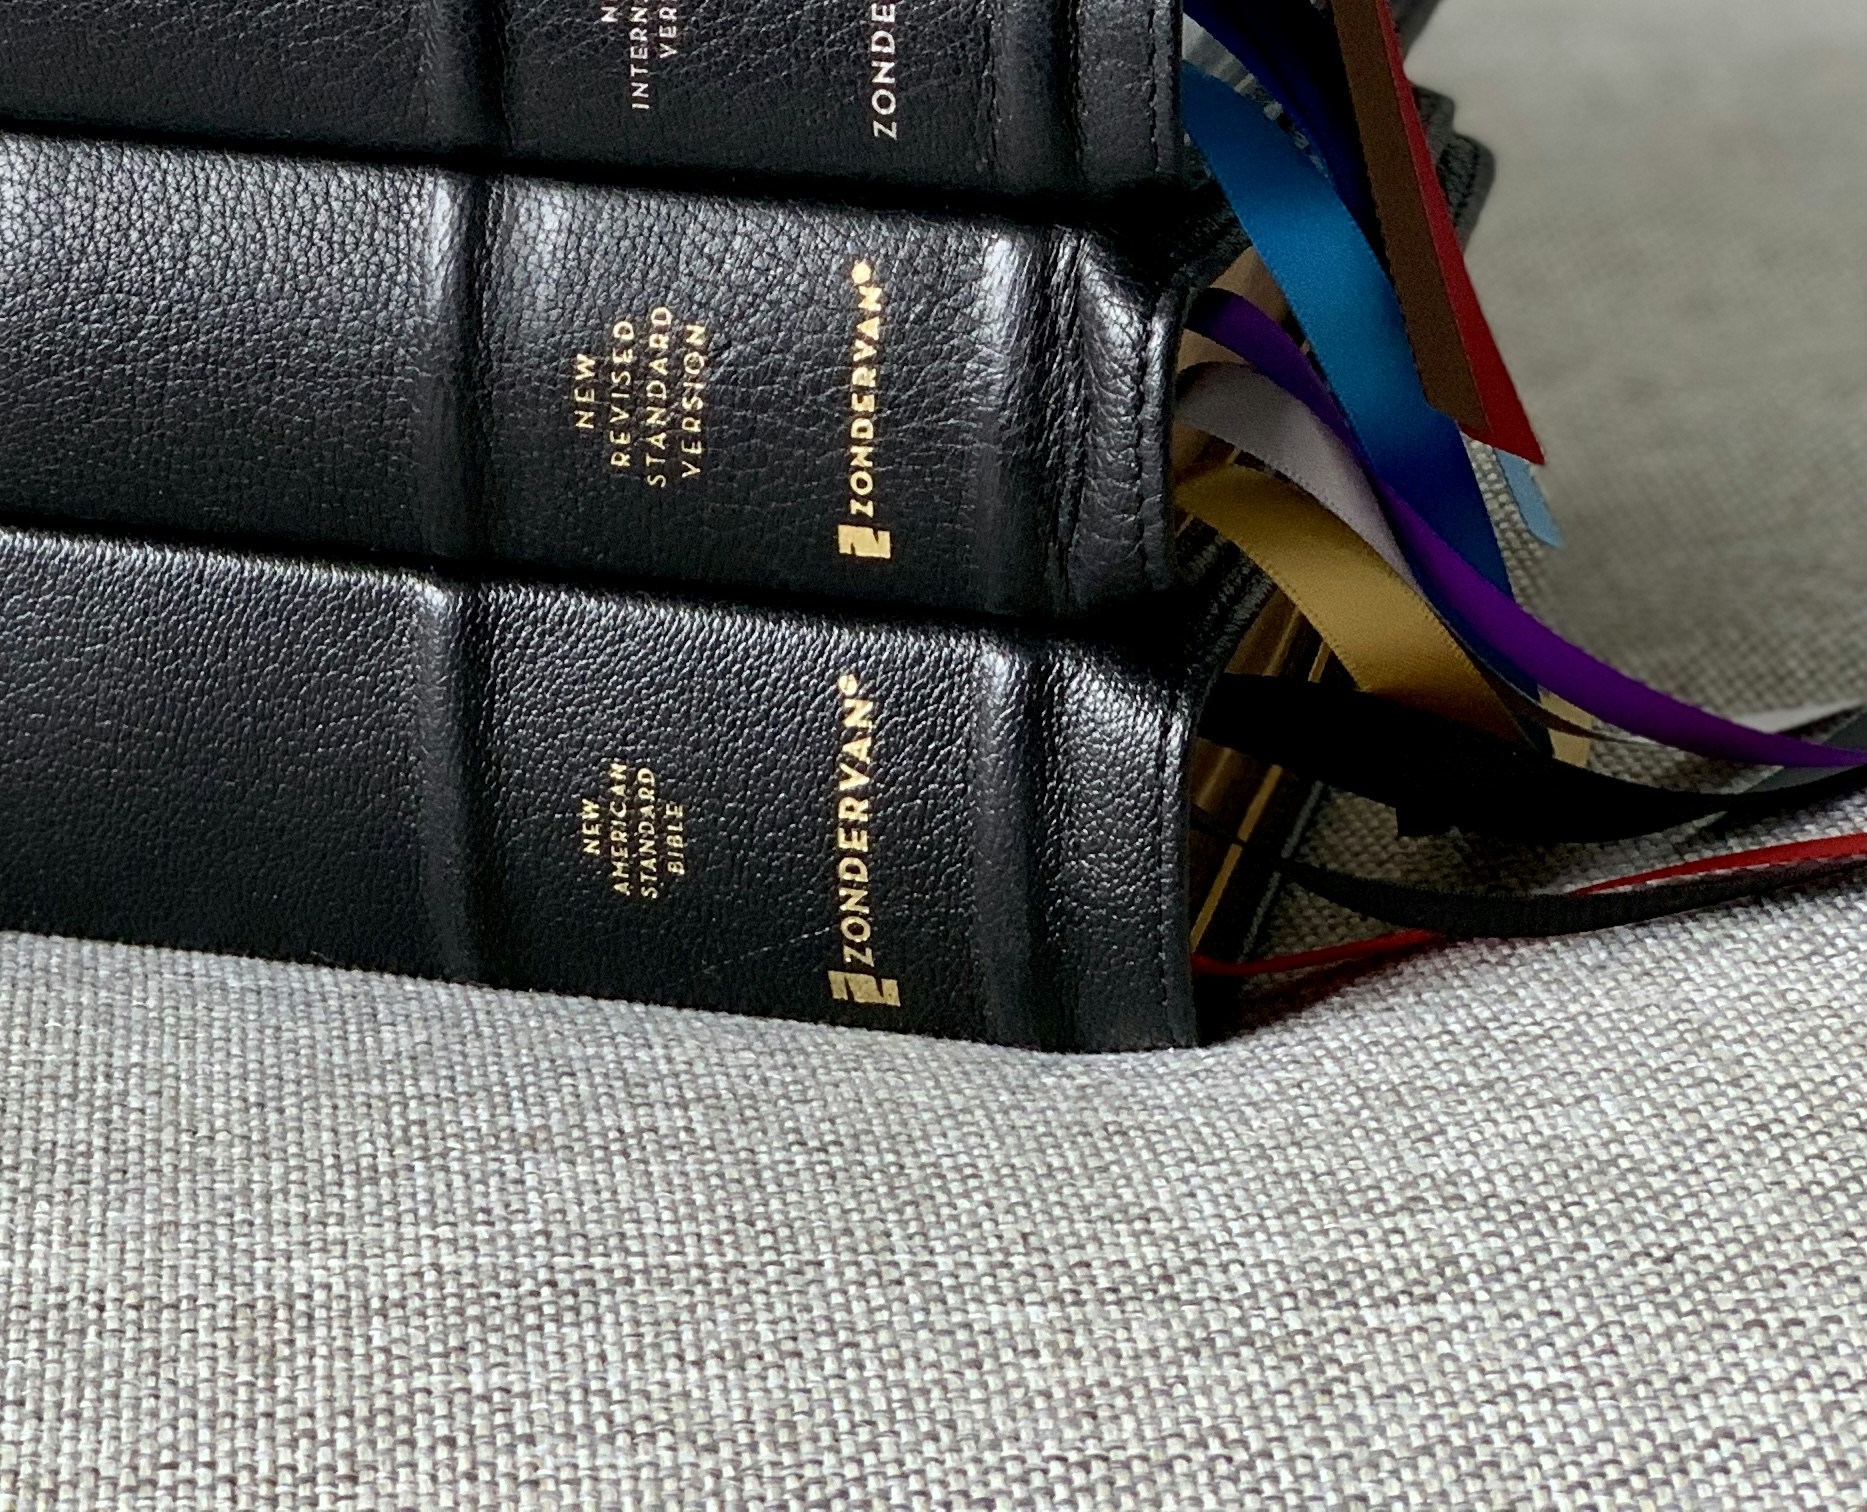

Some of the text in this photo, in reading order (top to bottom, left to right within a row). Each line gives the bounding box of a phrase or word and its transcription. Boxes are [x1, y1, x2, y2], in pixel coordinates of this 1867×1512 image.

[574, 354, 596, 429] NEW
[610, 320, 635, 468] REVISED
[646, 306, 672, 488] STANDARD
[681, 323, 706, 479] VERSION
[581, 799, 601, 856] NEW
[610, 761, 631, 896] AMERICAN
[638, 767, 658, 899] STANDARD
[666, 801, 686, 876] BIBLE
